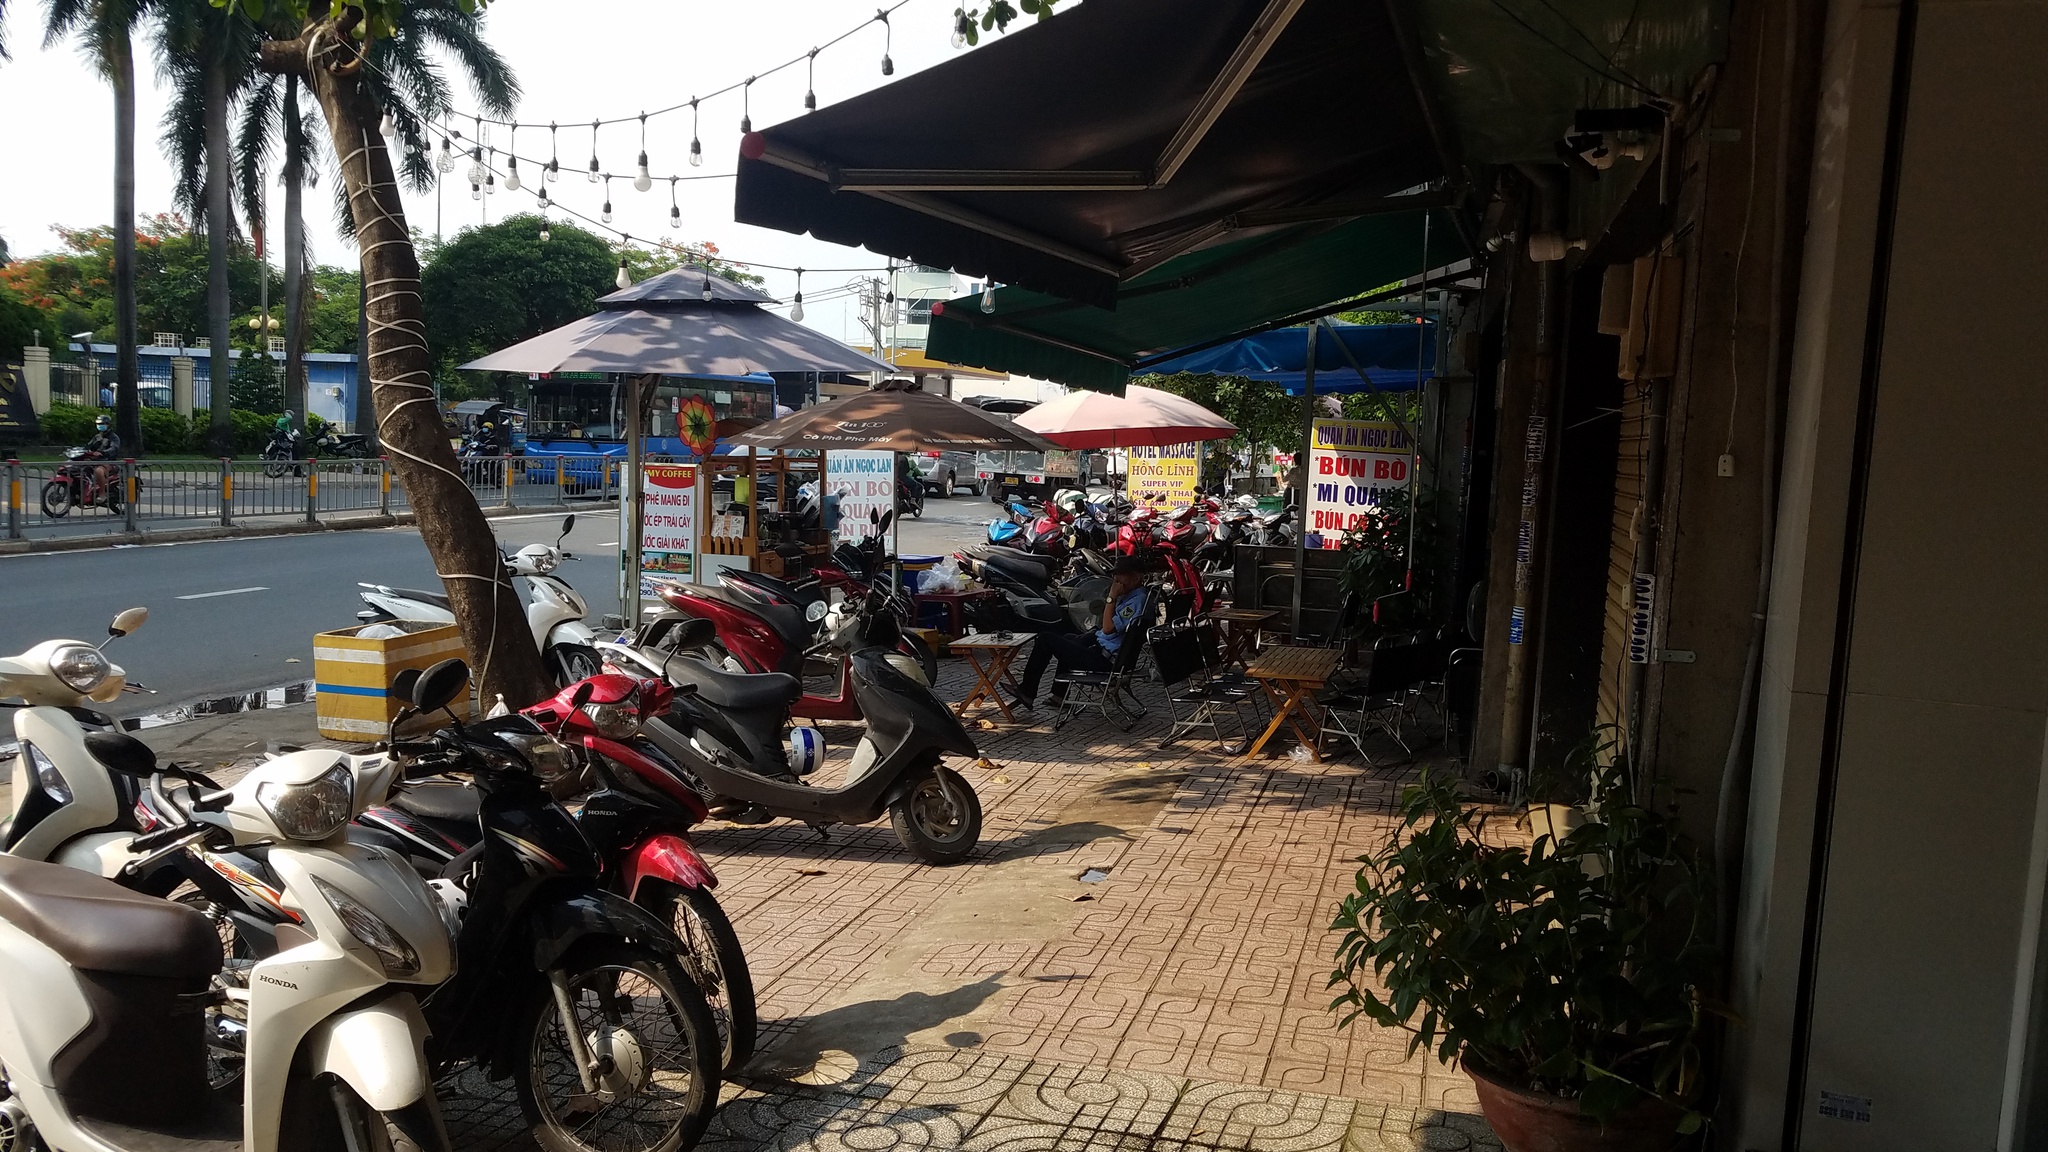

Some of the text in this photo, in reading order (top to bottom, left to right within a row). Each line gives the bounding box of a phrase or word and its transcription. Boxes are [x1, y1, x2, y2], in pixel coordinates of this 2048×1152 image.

[868, 435, 893, 444] Máy
[1318, 424, 1407, 451] QUÁN ĂN NGỌC LAN
[1131, 442, 1195, 459] HOTEL MASSAGE
[826, 454, 892, 477] UÁN ĂN NGỌC LAN
[1132, 460, 1163, 476] HỒNG
[1374, 458, 1407, 481] BÒ
[662, 470, 692, 479] COFFEE
[866, 477, 893, 497] BÒ
[1169, 480, 1184, 488] VIP
[1173, 488, 1193, 497] THÁI
[661, 495, 681, 506] MANG
[682, 495, 690, 507] ĐI
[1150, 499, 1167, 507] AND
[654, 512, 662, 527] ÉP
[664, 513, 678, 528] TRÁI
[679, 514, 691, 528] CÂY
[657, 535, 670, 549] GIẢI
[672, 536, 690, 549] KHÁT
[259, 974, 299, 991] HONDA
